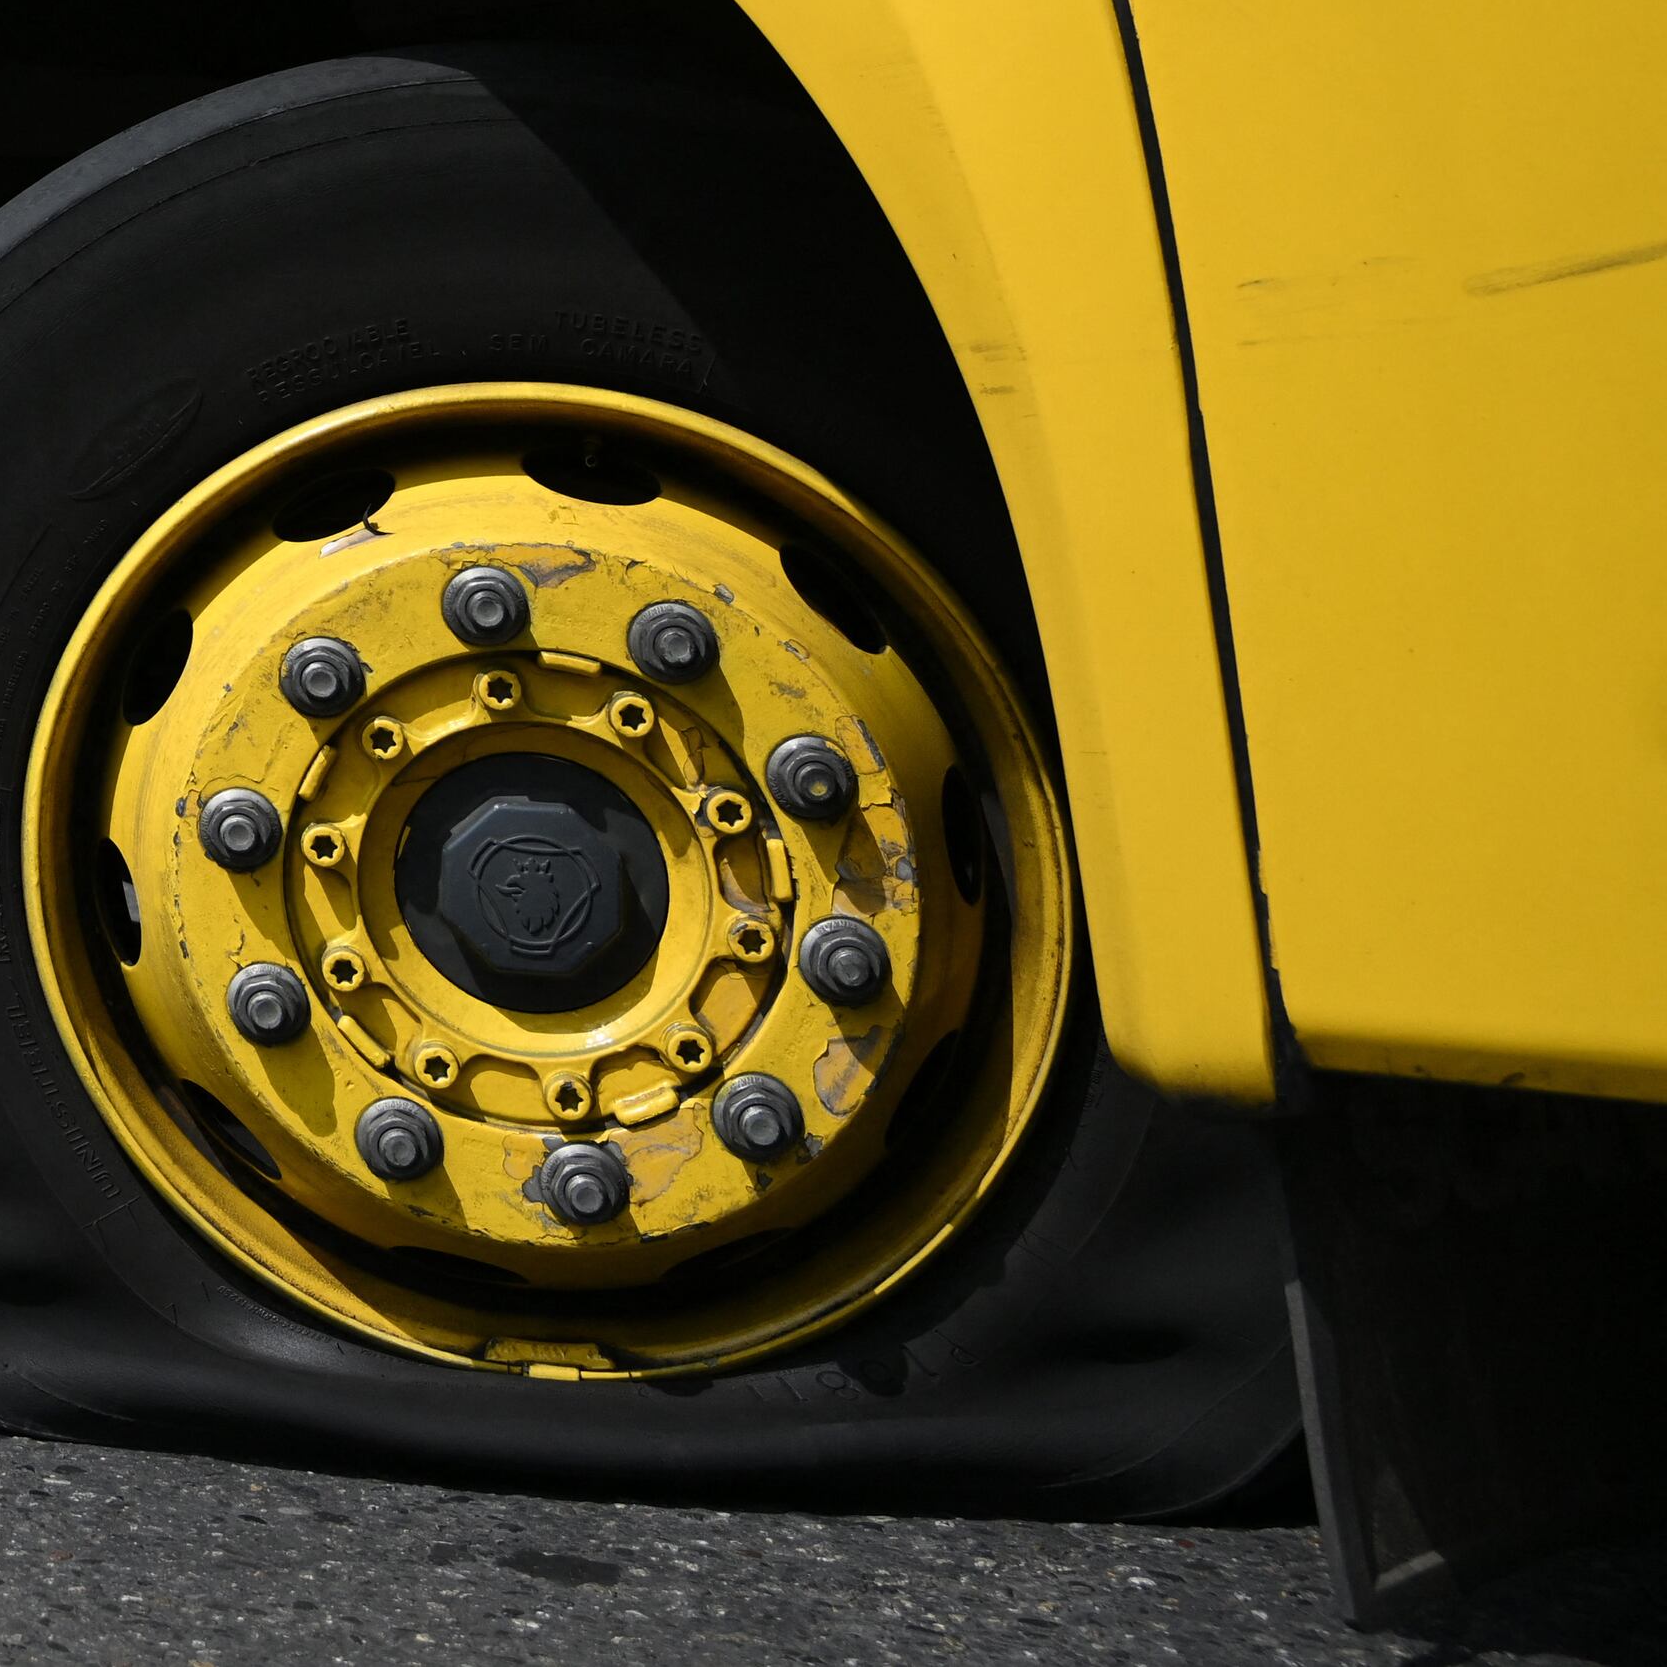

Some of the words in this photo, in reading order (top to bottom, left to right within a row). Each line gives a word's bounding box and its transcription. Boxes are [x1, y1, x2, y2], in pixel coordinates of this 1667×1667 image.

[487, 333, 549, 354] SEM
[579, 337, 695, 375] CAMARA
[553, 310, 704, 356] TUBELESS
[5, 1002, 123, 1200] UNISTEEL
